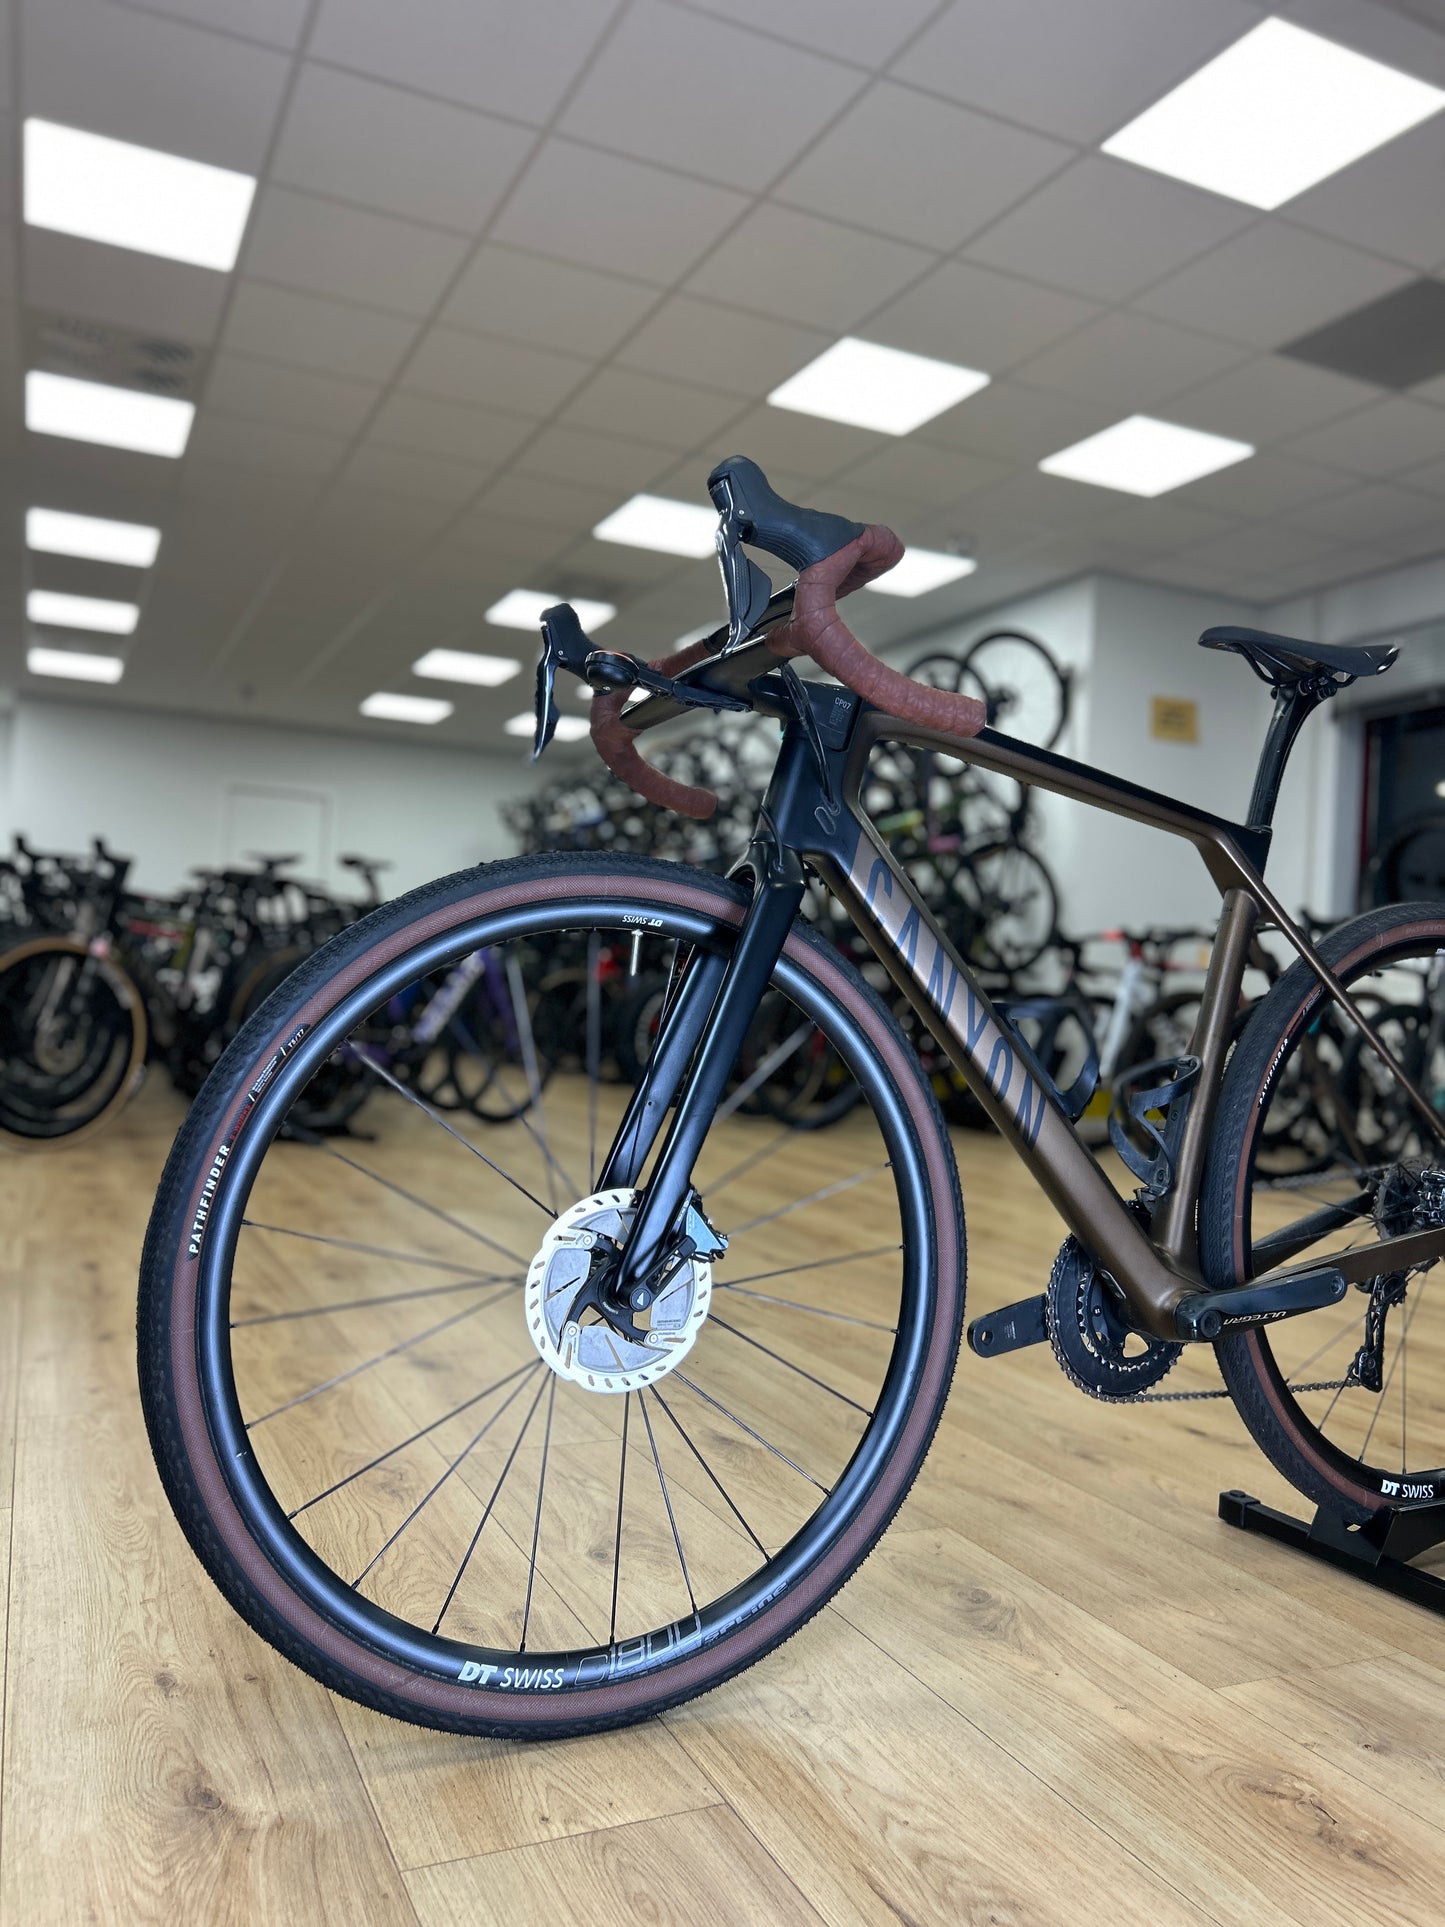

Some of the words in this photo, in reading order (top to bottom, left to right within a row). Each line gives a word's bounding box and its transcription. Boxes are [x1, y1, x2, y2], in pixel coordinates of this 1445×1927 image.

[834, 696, 852, 710] CP07
[622, 915, 647, 924] SWISS
[648, 919, 663, 927] DT
[864, 857, 1047, 1149] CANYON
[1258, 1037, 1289, 1105] PATHFINDER
[188, 1144, 230, 1254] PATHFINDER
[1223, 1310, 1287, 1326] ULTEGRA
[1380, 1479, 1400, 1497] DT
[1401, 1483, 1434, 1499] SWISS
[457, 1660, 498, 1685] DT
[499, 1667, 565, 1689] SWISS
